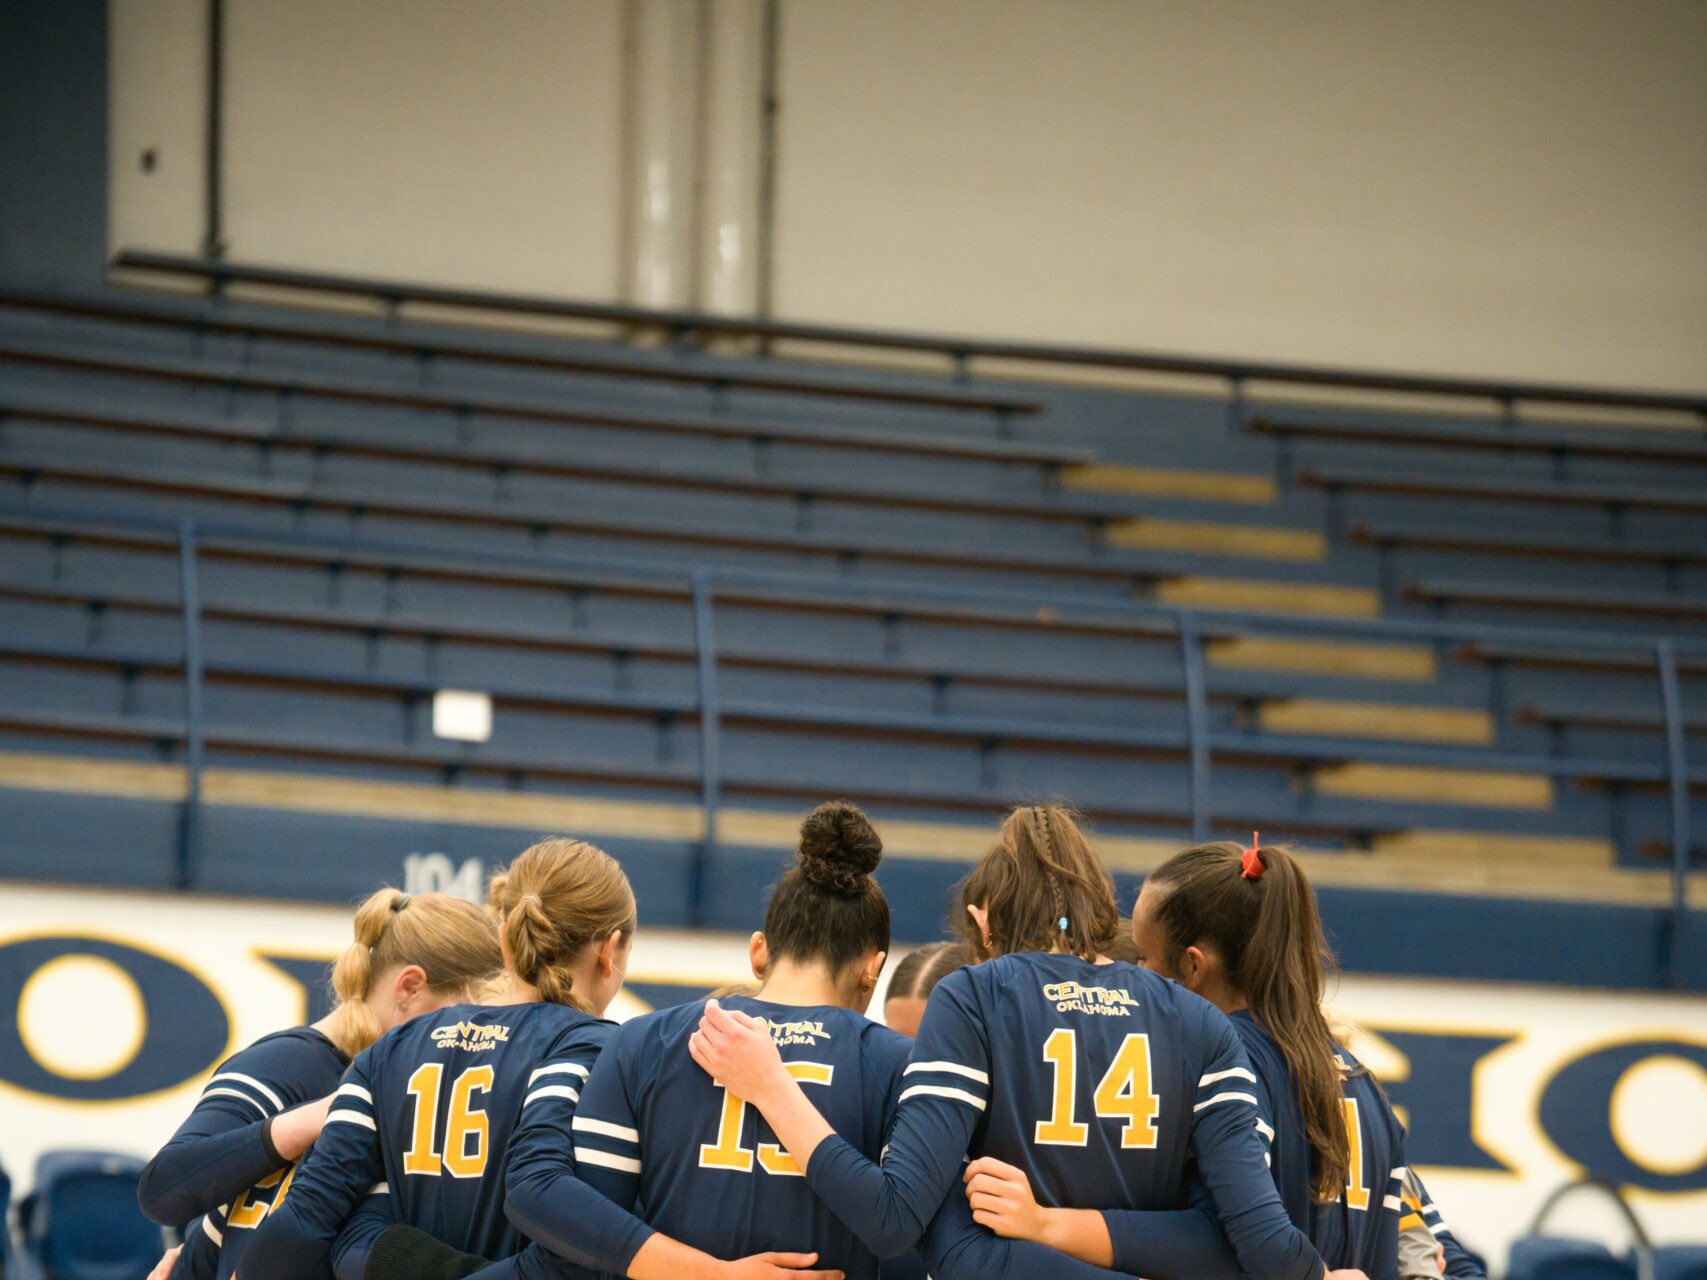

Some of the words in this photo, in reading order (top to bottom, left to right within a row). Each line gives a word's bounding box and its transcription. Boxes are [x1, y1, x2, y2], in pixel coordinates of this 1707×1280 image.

[404, 852, 482, 906] 104
[1043, 981, 1139, 1006] CENTRAL
[1056, 999, 1131, 1016] OKLAHOMA
[431, 1021, 510, 1041] CENTRAL
[1034, 1027, 1160, 1149] 14
[403, 1062, 495, 1178] 16
